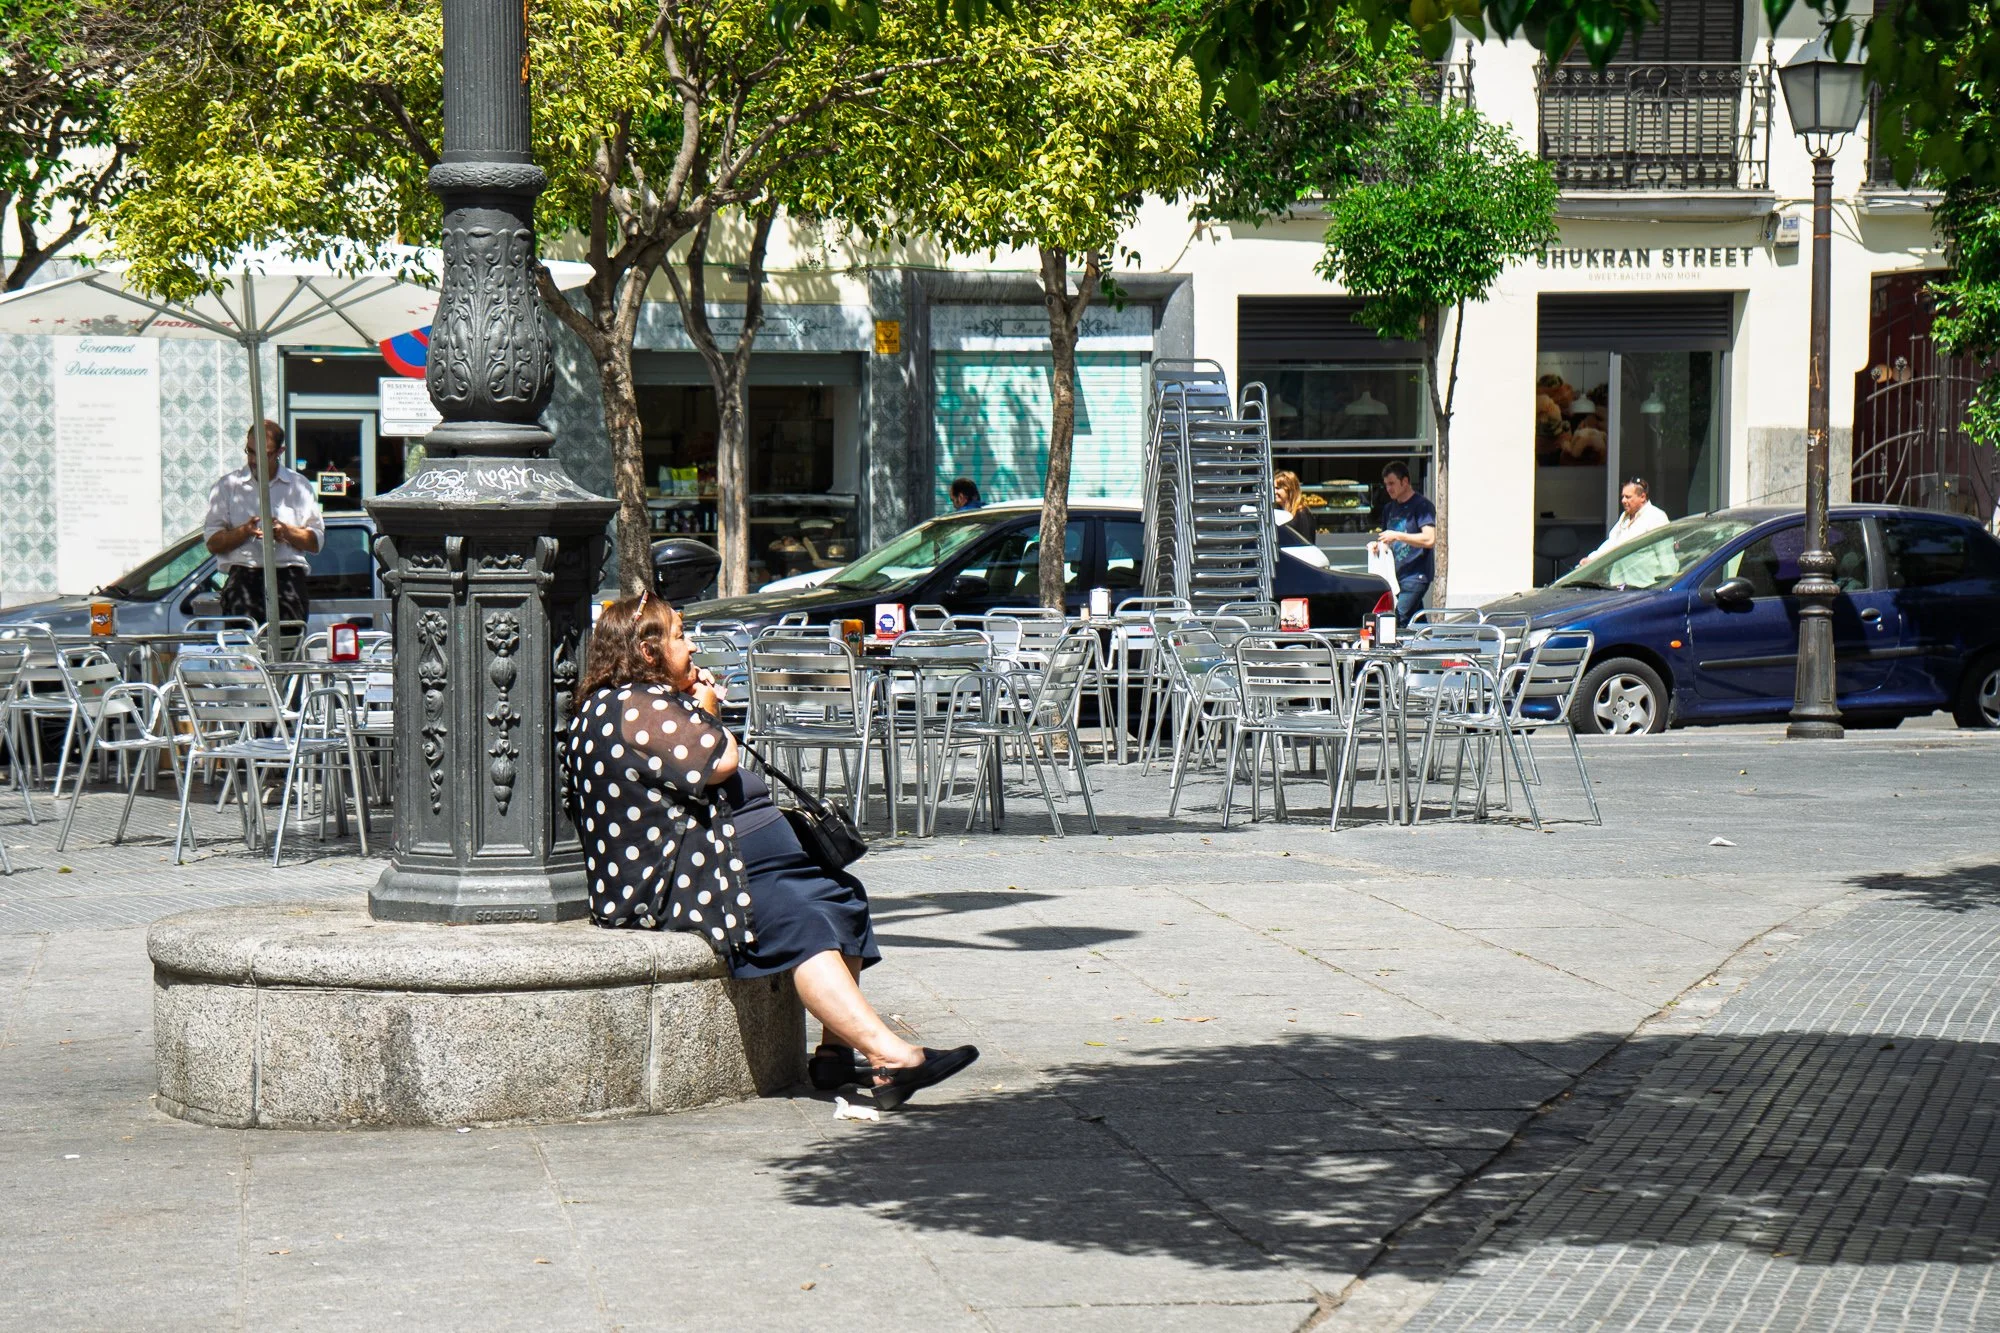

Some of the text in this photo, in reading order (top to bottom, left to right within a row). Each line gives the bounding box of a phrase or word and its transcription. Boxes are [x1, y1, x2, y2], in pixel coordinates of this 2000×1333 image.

[1662, 247, 1753, 268] STREET
[76, 339, 136, 354] Gourmet
[64, 360, 150, 376] Delicatessen
[475, 908, 539, 922] SOCIEDAD
